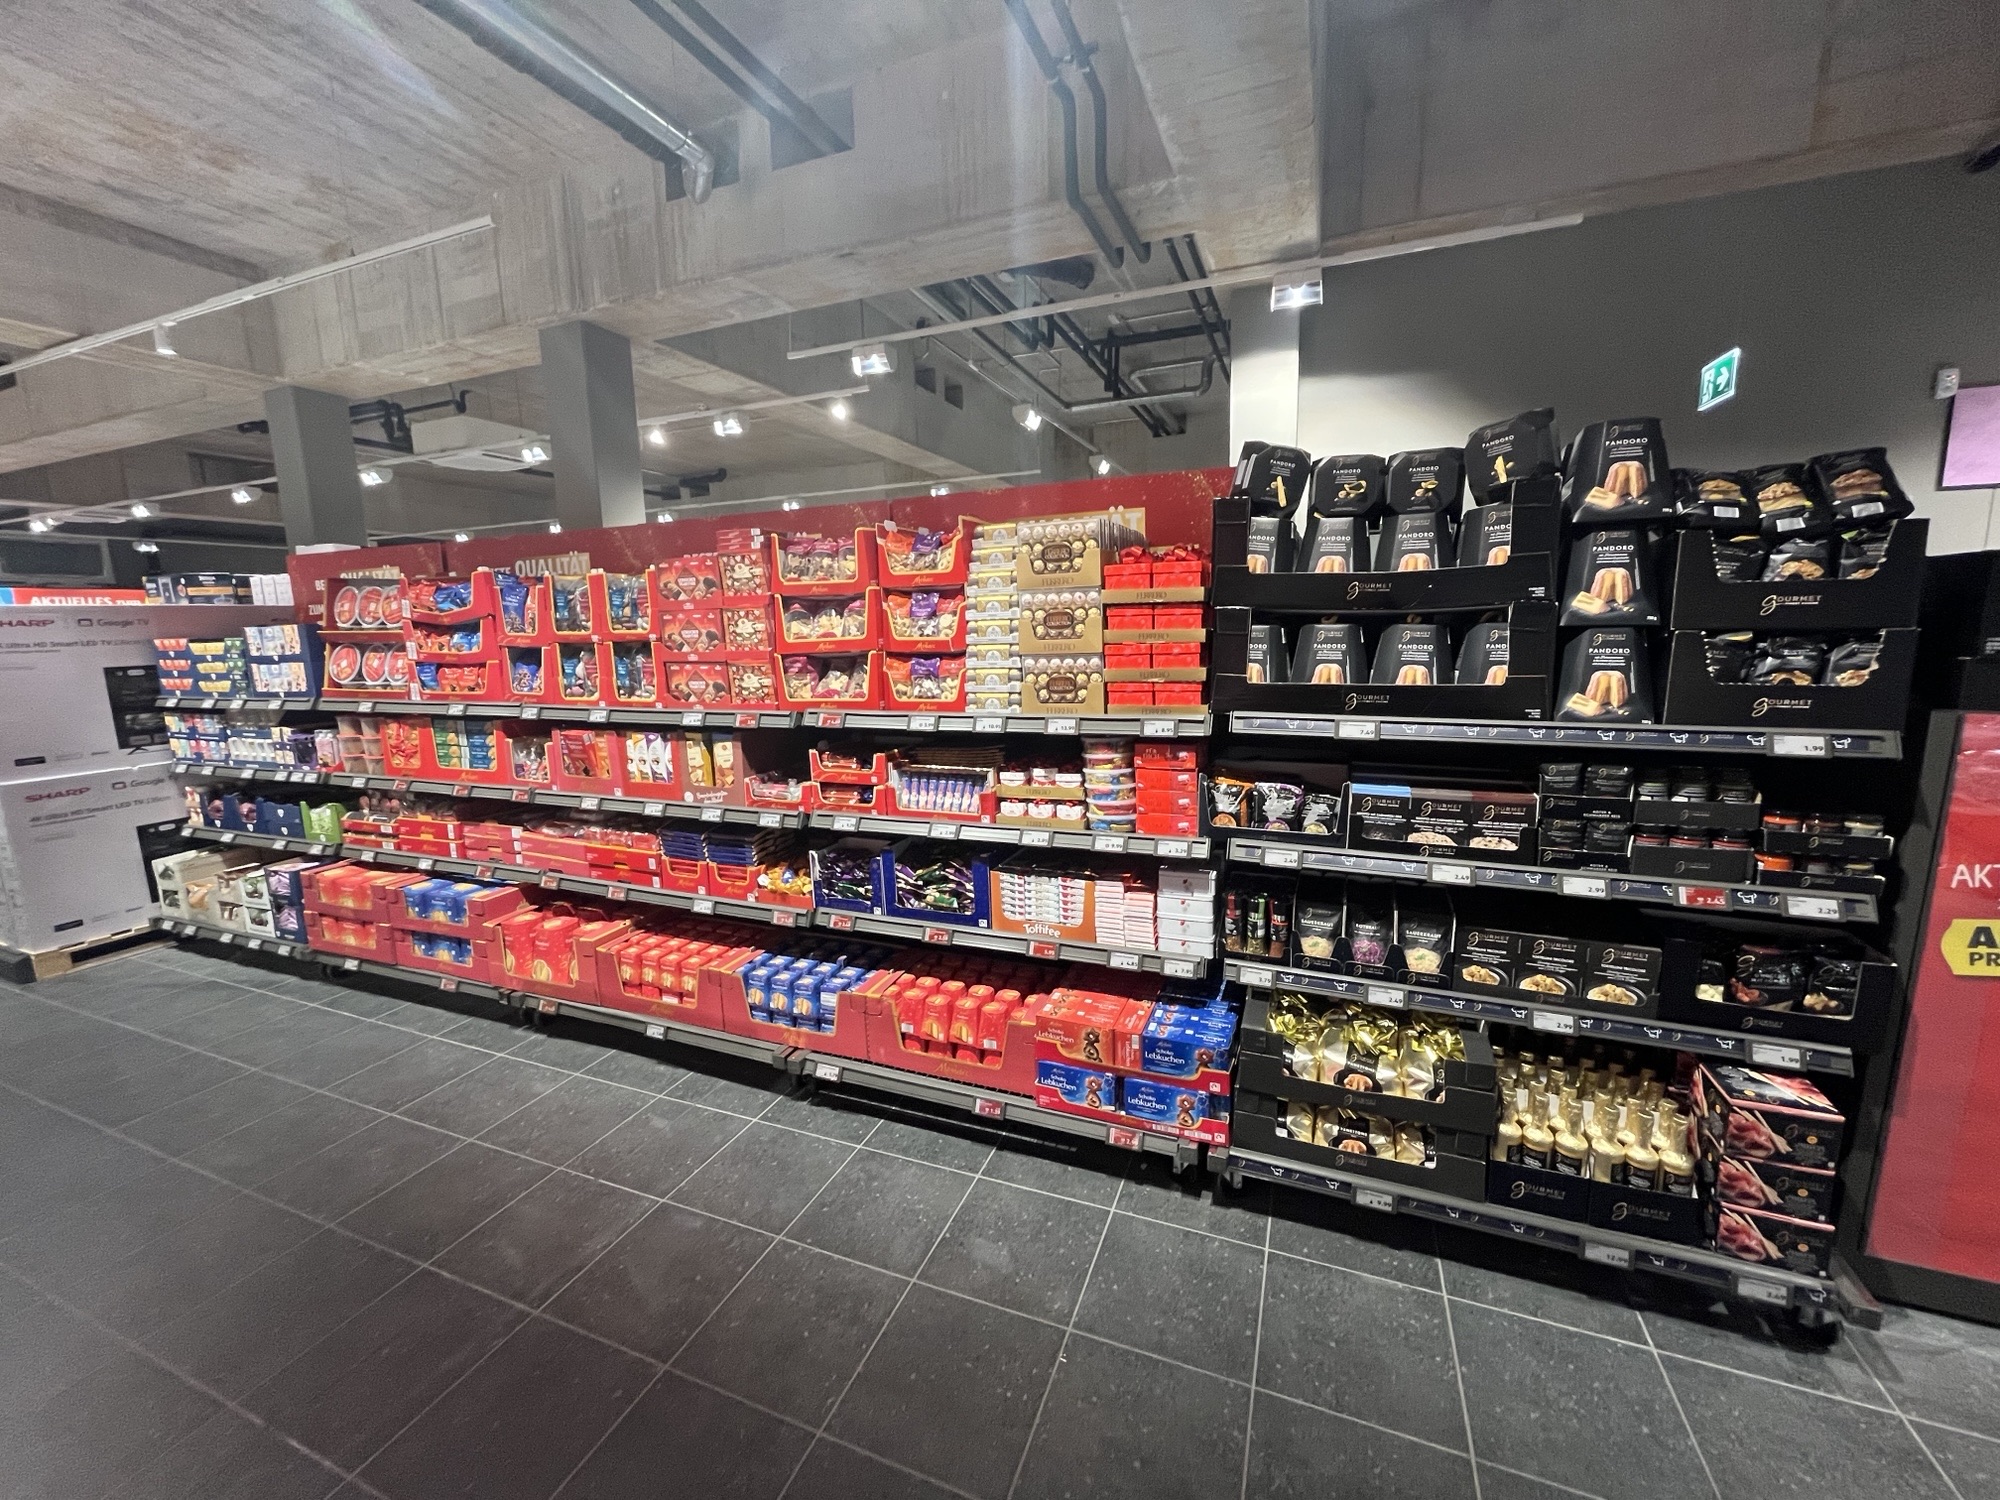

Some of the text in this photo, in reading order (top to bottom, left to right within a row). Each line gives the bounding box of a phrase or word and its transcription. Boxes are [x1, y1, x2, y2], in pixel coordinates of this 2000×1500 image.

[1482, 434, 1515, 449] PANDORO
[1605, 437, 1648, 447] PANDORO
[1270, 459, 1296, 468] PANDORO
[1408, 465, 1440, 473] PANDORO
[1398, 531, 1435, 539] PANDORO
[515, 551, 590, 578] QUALITÄT
[1042, 577, 1074, 586] FERRERO
[1347, 581, 1392, 600] GOURMET
[1760, 594, 1822, 616] GOURMET
[0, 619, 55, 628] HARP
[97, 618, 134, 628] Google
[1043, 643, 1076, 651] FERRERO
[1345, 692, 1390, 711] GOURMET
[1752, 697, 1812, 718] GOURMET
[130, 777, 166, 788] Google
[25, 786, 91, 803] SHARP
[1361, 797, 1401, 811] GOURMET
[1421, 801, 1462, 816] GOURMET
[1483, 804, 1527, 821] GOURMET
[1950, 864, 2000, 889] AK
[1817, 907, 1838, 915] 2.29
[1023, 923, 1061, 939] Toffifee
[1467, 931, 1510, 946] GOURMET
[1533, 939, 1578, 955] GOURMET
[1602, 948, 1649, 963] GOURMET
[1557, 1022, 1573, 1030] 2.99
[1038, 1031, 1075, 1044] Lebkuchen
[1145, 1050, 1185, 1065] Lebkuchen
[1155, 1048, 1174, 1056] Schoko
[1781, 1055, 1800, 1063] 1.99
[1041, 1077, 1077, 1091] Lebkuchen
[1050, 1074, 1067, 1082] Schoko
[1127, 1097, 1167, 1110] Lebkuchen
[1138, 1093, 1157, 1101] Schoko
[1510, 1180, 1566, 1200] GOURMET
[1611, 1202, 1671, 1221] GOURMET
